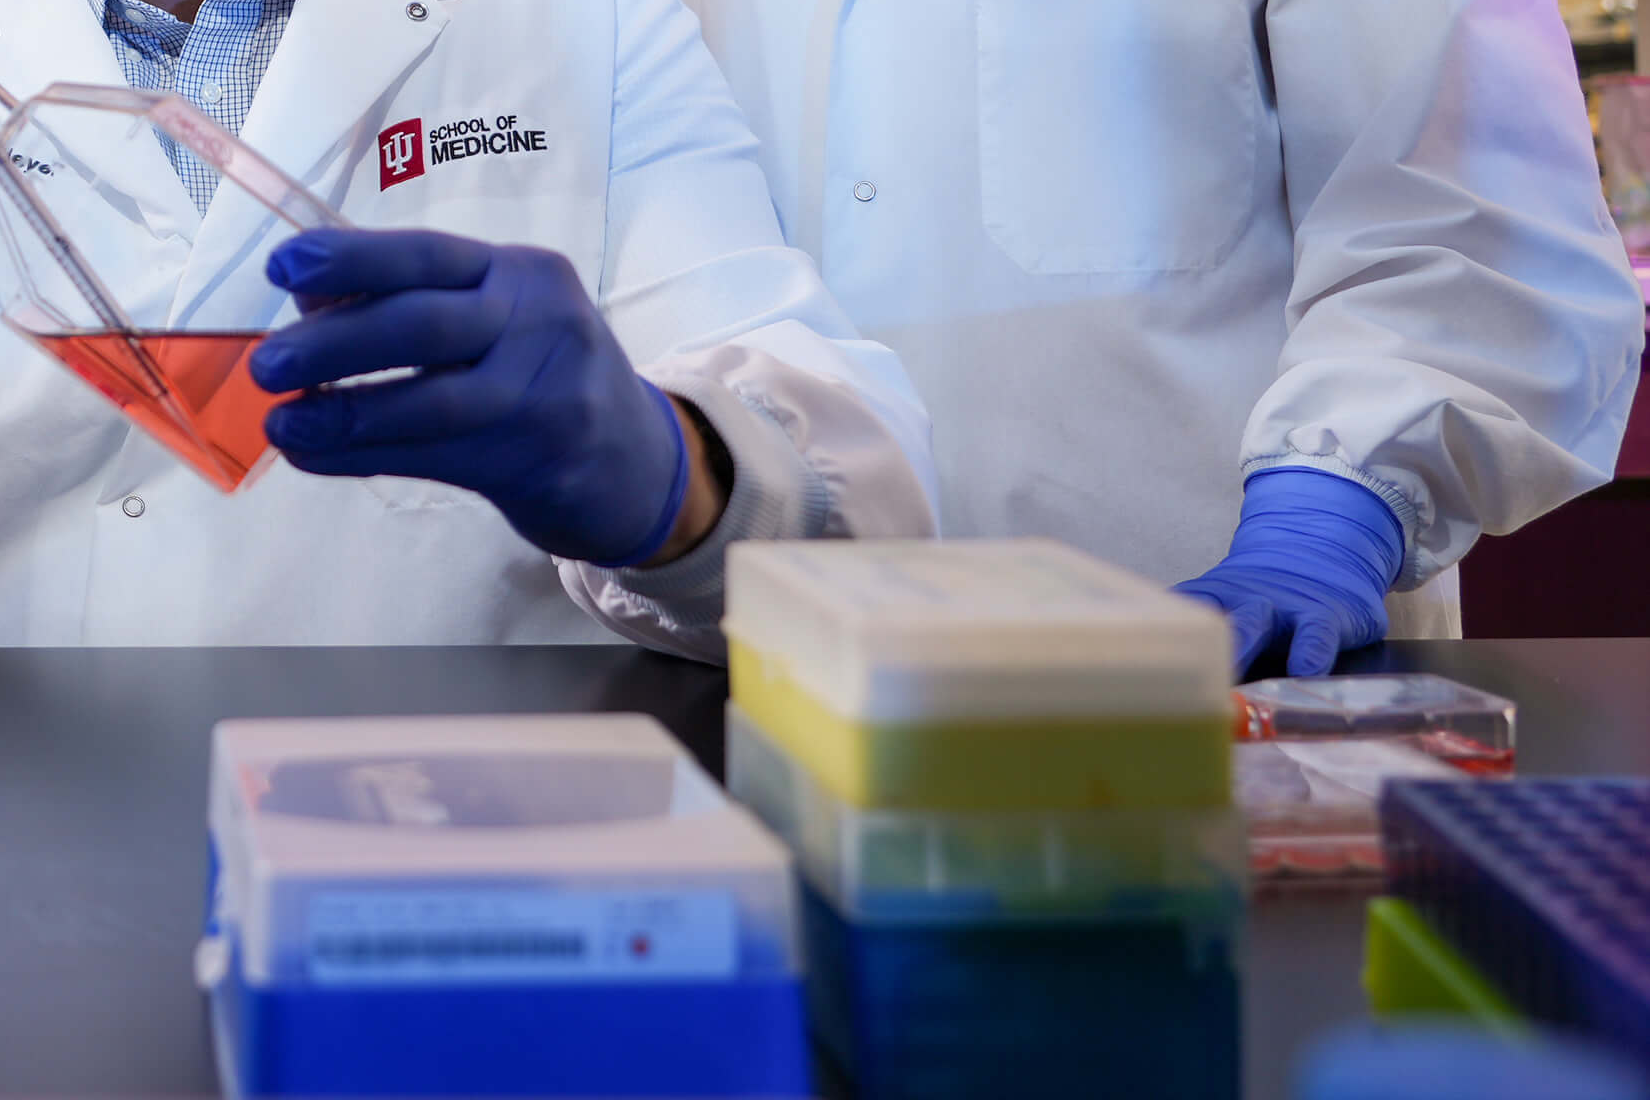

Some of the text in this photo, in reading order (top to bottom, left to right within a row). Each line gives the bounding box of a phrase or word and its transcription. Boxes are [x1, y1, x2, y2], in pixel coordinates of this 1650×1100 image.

[429, 115, 517, 144] SCHOOL OF
[431, 130, 548, 166] MEDICINE
